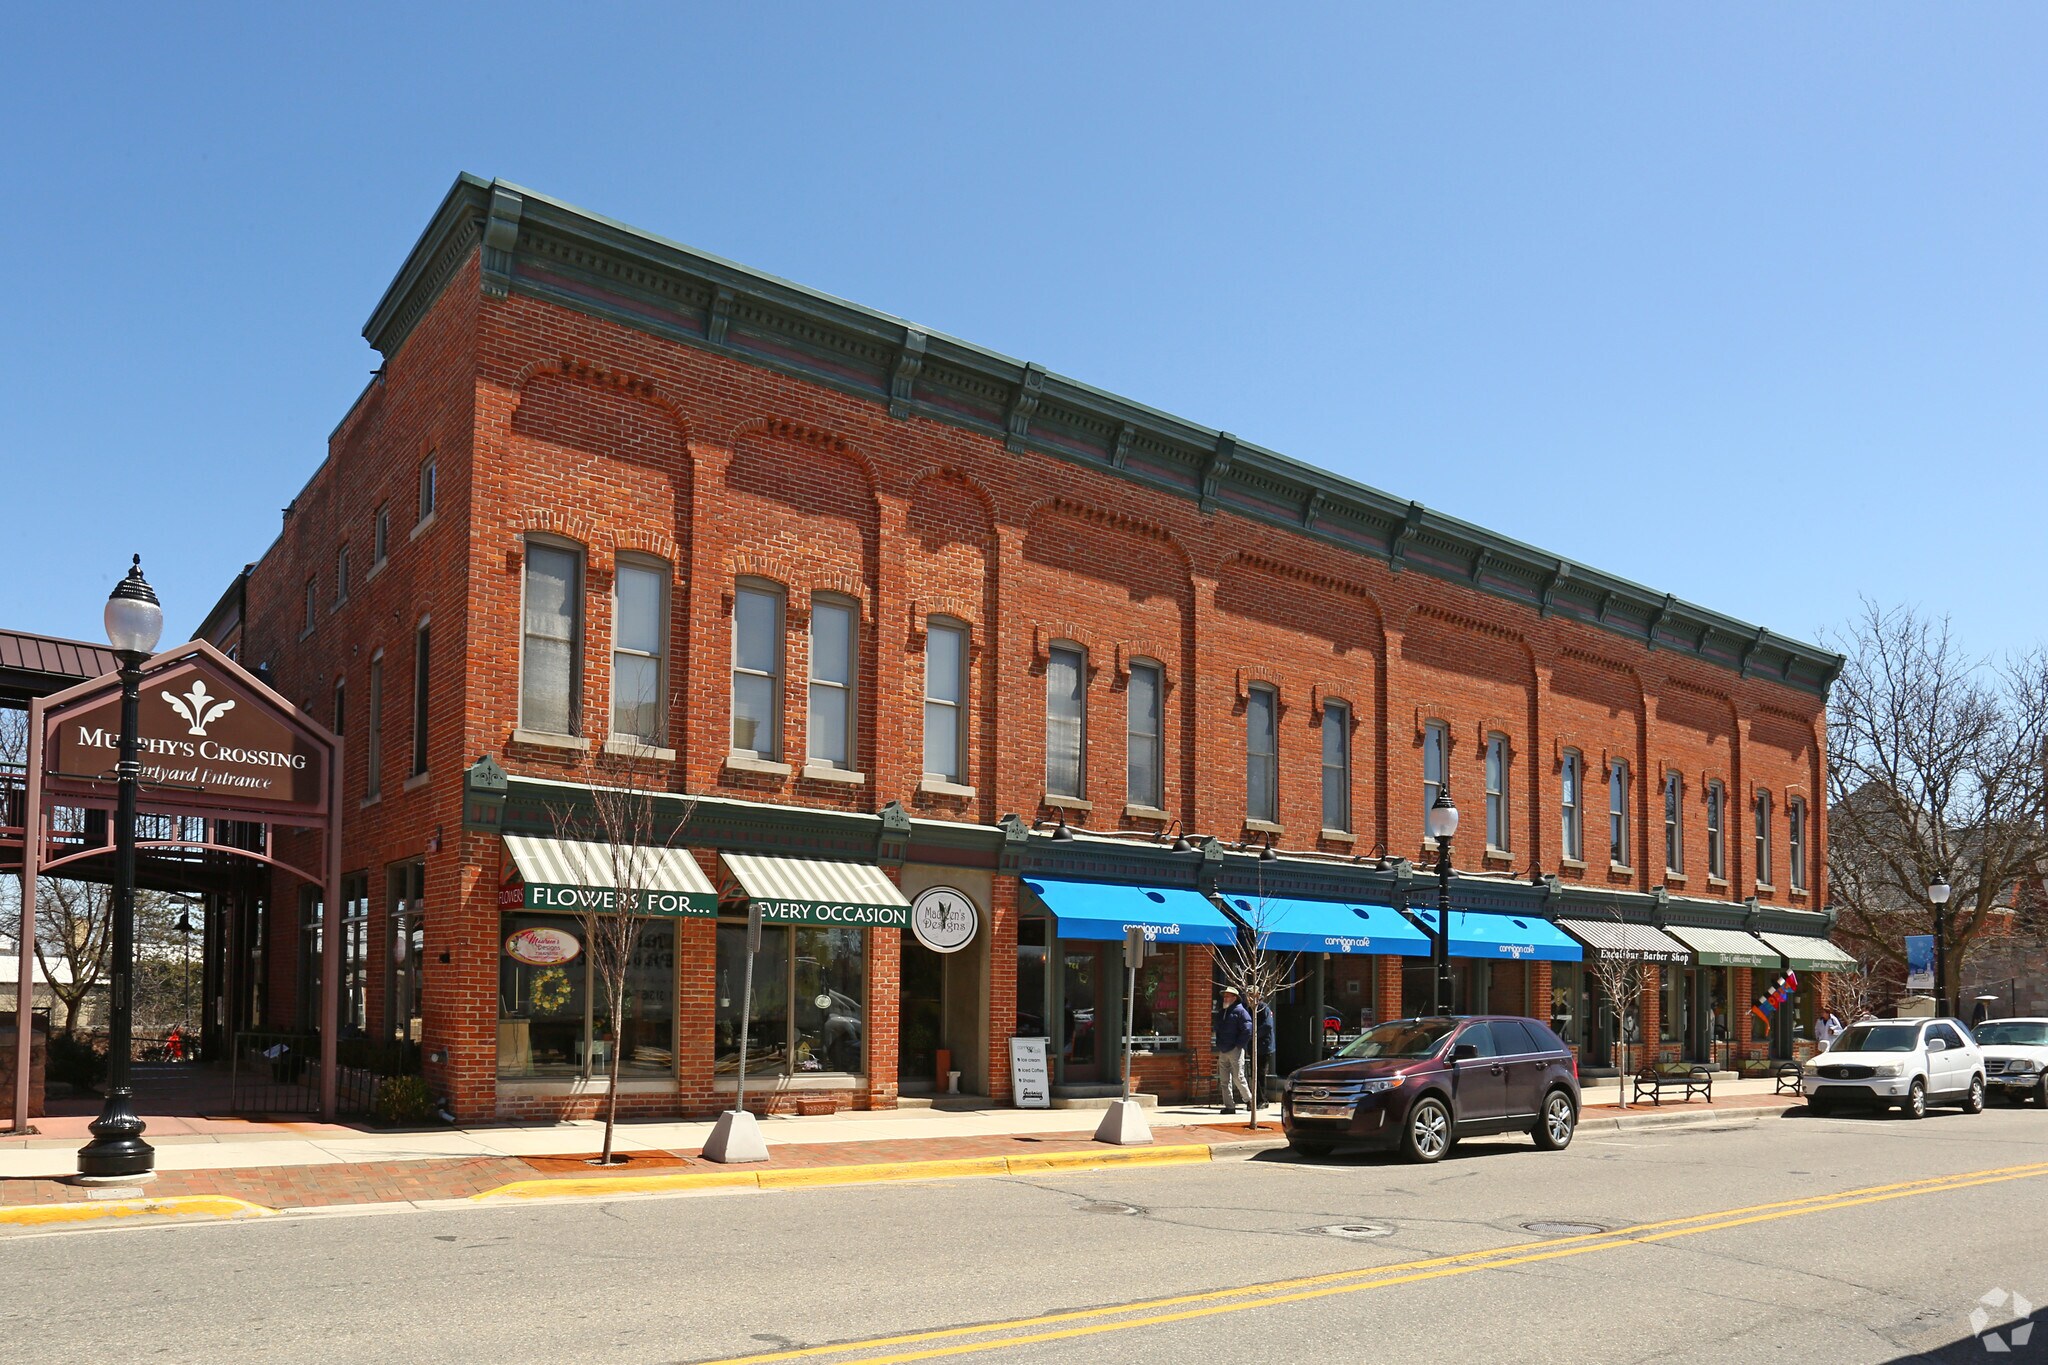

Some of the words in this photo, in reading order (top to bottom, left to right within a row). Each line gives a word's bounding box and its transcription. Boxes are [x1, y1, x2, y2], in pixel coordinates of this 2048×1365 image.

[78, 726, 195, 758] MUPHY'S
[200, 740, 307, 770] CROSSING
[115, 762, 199, 783] urtyard
[201, 768, 272, 790] Entrance
[533, 887, 639, 910] FLOWERS
[757, 901, 811, 919] EVERY
[816, 904, 906, 924] OCCASION
[924, 906, 966, 921] Maueen's
[923, 918, 966, 933] Desgns
[1643, 951, 1668, 961] Barber
[1671, 951, 1689, 966] Shop
